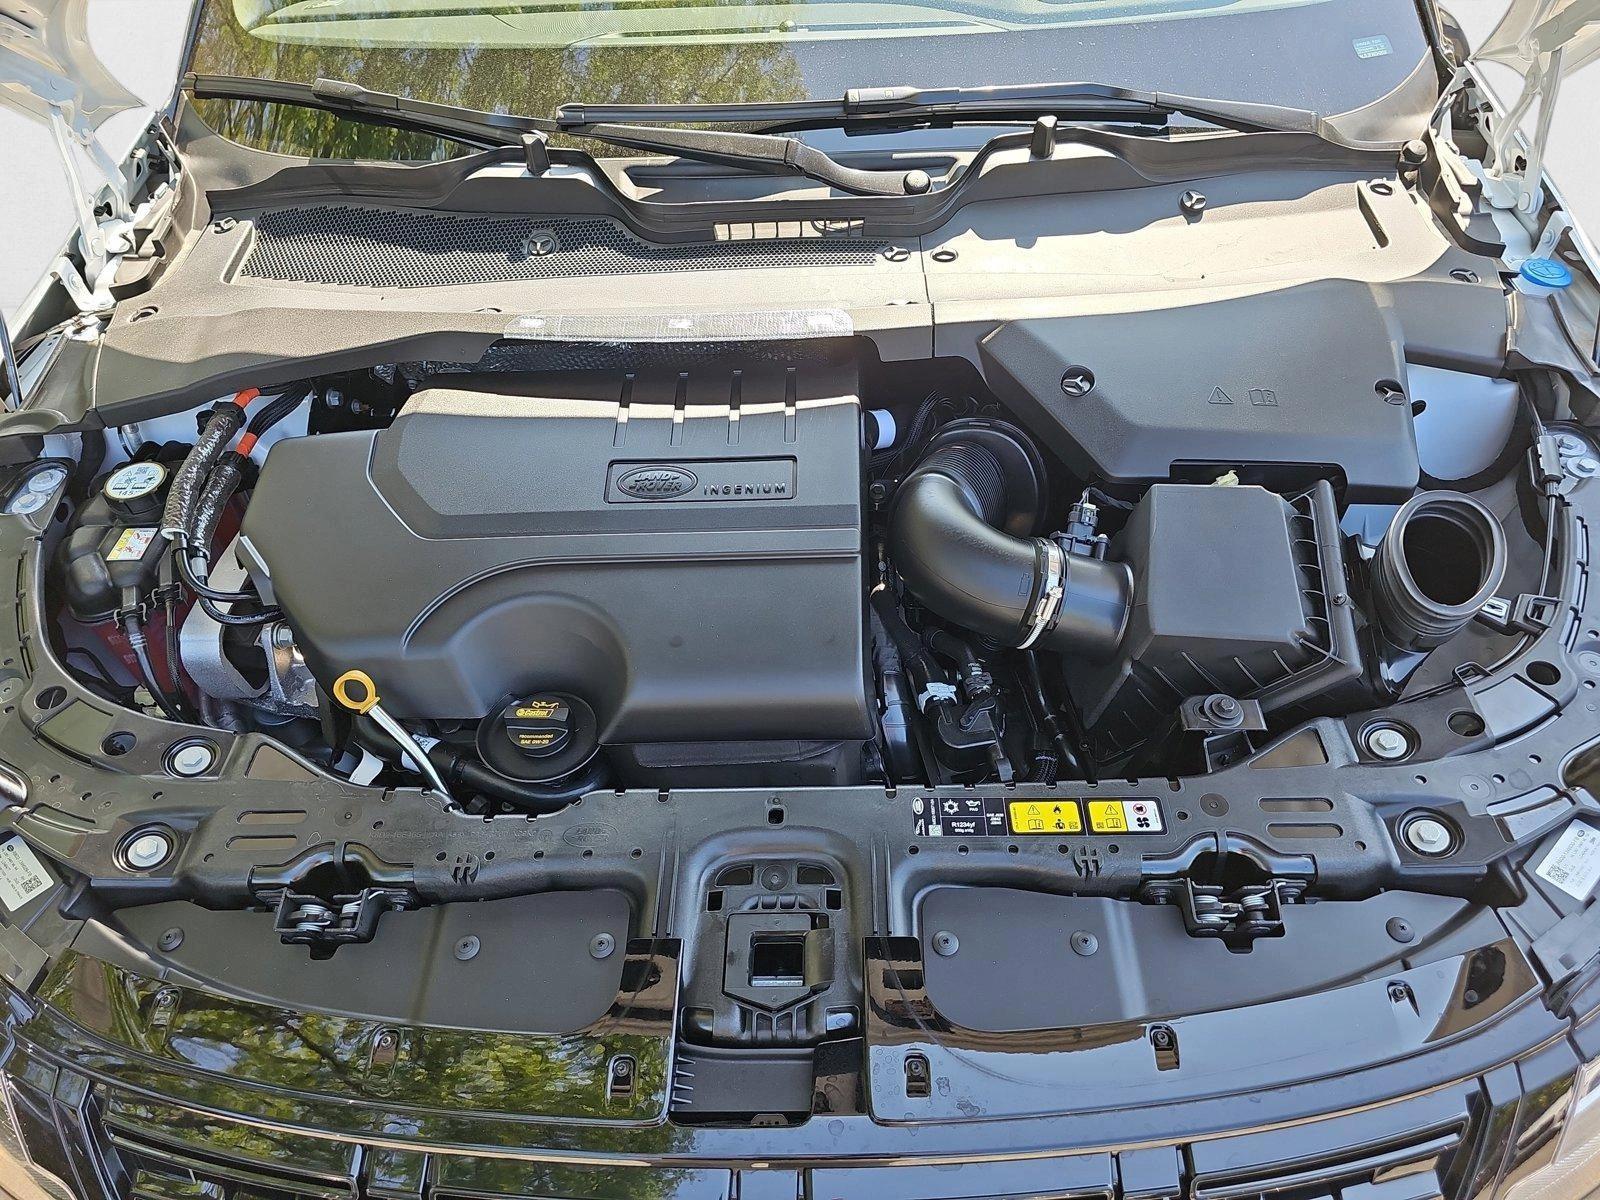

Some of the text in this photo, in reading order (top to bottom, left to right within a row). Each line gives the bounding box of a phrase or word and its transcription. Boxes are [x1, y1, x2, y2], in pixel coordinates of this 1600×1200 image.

[635, 473, 672, 482] LAND
[636, 482, 682, 492] ROVER
[704, 483, 786, 496] INGENIUM
